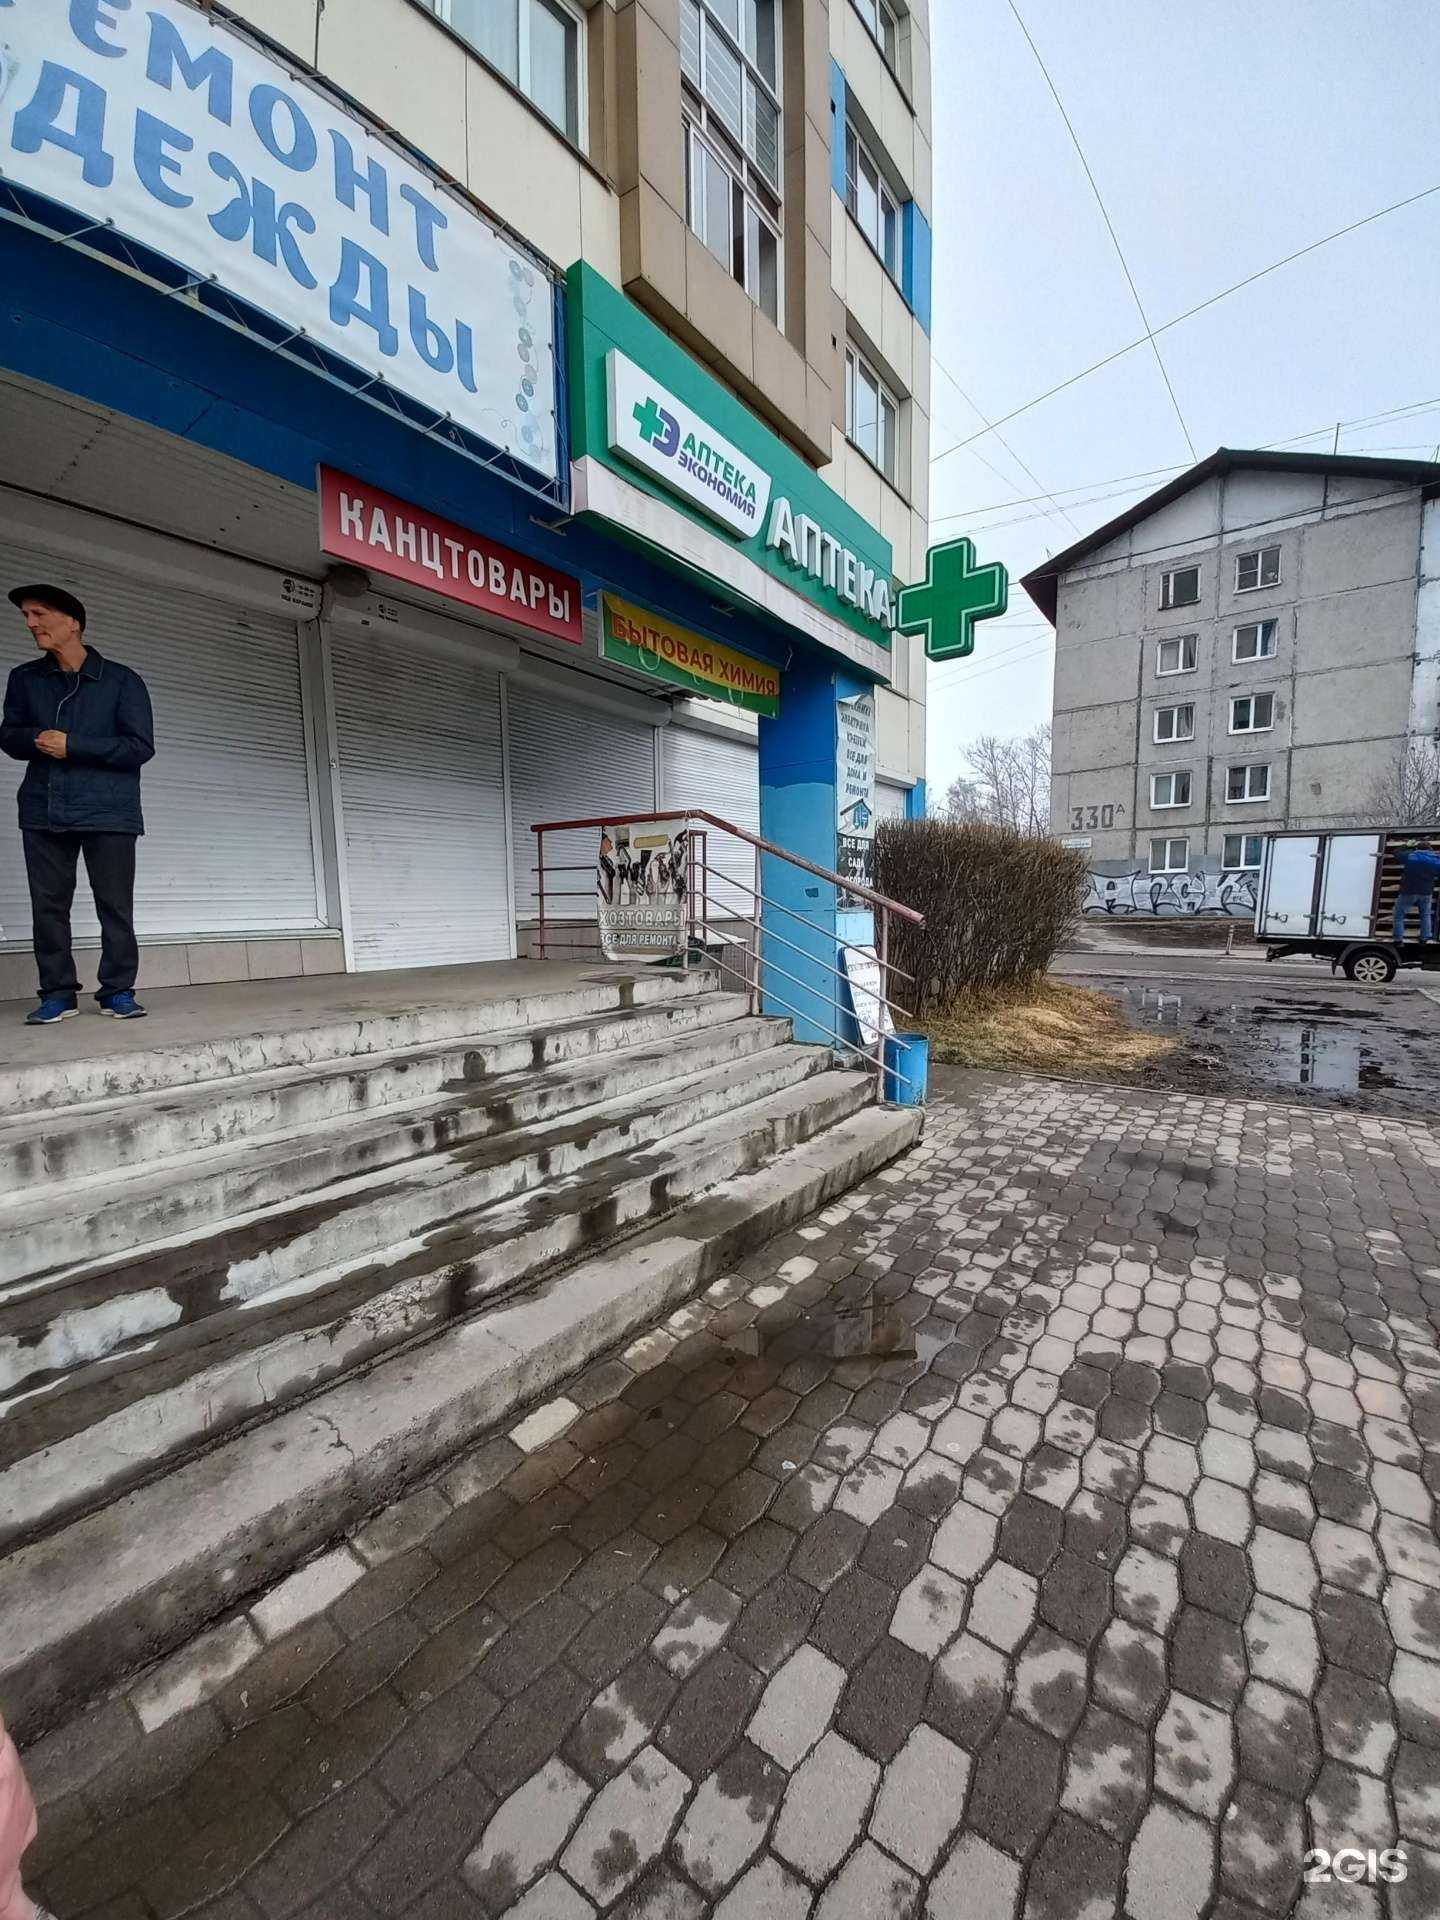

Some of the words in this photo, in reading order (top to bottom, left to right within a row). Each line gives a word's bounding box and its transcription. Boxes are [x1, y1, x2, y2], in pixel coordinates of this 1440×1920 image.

[0, 0, 447, 272] ЕМОНТ
[0, 60, 478, 393] ДЕЖДЫ
[678, 451, 756, 519] ЭКОНОМИЯ
[682, 432, 757, 504] АПТЕКА
[338, 493, 571, 623] КАНЦТОВАРЫ
[766, 496, 896, 631] АПТЕКА
[612, 612, 714, 674] БЫТОВАЯ
[720, 658, 776, 696] ХИМИЯ
[842, 838, 856, 849] ВСЕ
[848, 857, 865, 868] САДА
[599, 910, 685, 927] ХОЗТОВАРЫ
[619, 934, 637, 946] ДЛЯ
